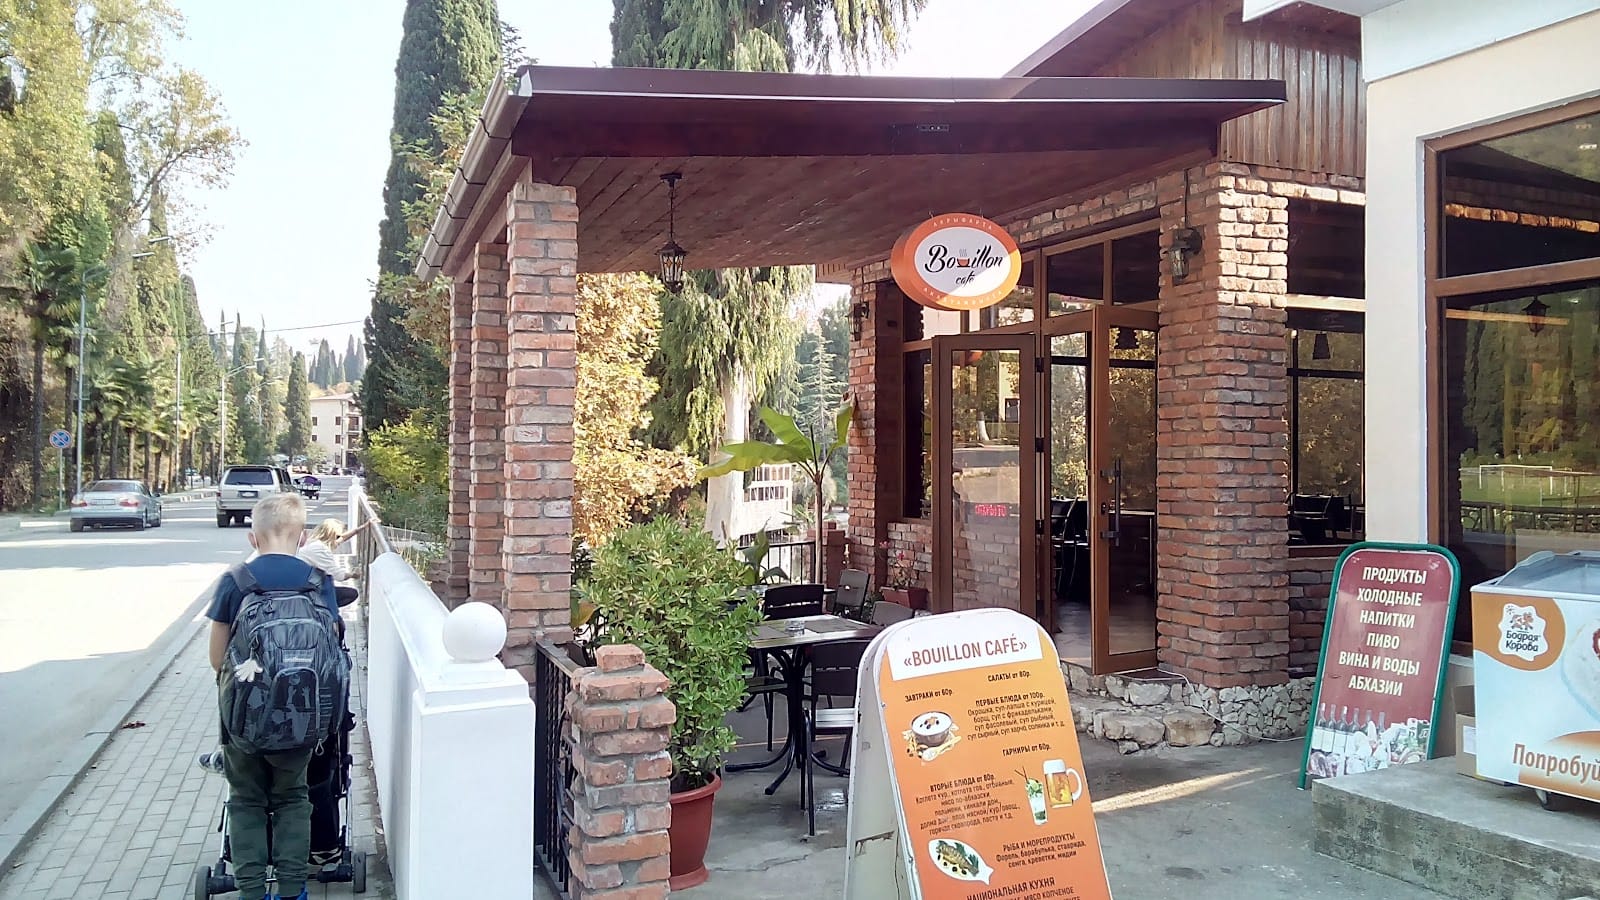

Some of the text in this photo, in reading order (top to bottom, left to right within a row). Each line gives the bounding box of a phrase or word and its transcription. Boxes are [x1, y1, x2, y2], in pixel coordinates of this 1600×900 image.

[924, 244, 1003, 272] Bouillon
[1362, 566, 1427, 584] ПРОДУКТЫ
[1357, 588, 1422, 606] ХОЛОДНЫЕ
[1360, 610, 1415, 628] НАПИТКИ
[1366, 632, 1400, 649] ПИВО
[1506, 630, 1539, 642] Бодрая
[904, 632, 1027, 666] «BOUILLON CAFÉ»
[1506, 640, 1539, 652] Корова
[1339, 652, 1420, 676] ВИНА И ВОДЫ
[988, 673, 1011, 682] САЛАТЫ
[1348, 675, 1403, 696] АБХАЗИИ
[905, 691, 934, 702] ЗАВТРАКИ
[976, 697, 999, 706] ПЕРВЫЕ
[1000, 694, 1022, 704] БЛЮДА
[1002, 745, 1030, 756] ГАРНИРЫ
[1513, 744, 1600, 784] Попробуй
[930, 782, 953, 792] ВТОРЫЕ
[954, 777, 975, 787] БЛЮДА
[1003, 844, 1020, 852] РЫБА
[1026, 832, 1075, 848] МОРЕПРОДУКТЫ
[1057, 850, 1076, 858] мидии
[1029, 877, 1055, 890] КУХНЯ
[1042, 886, 1074, 898] КОПЧЕНОЕ
